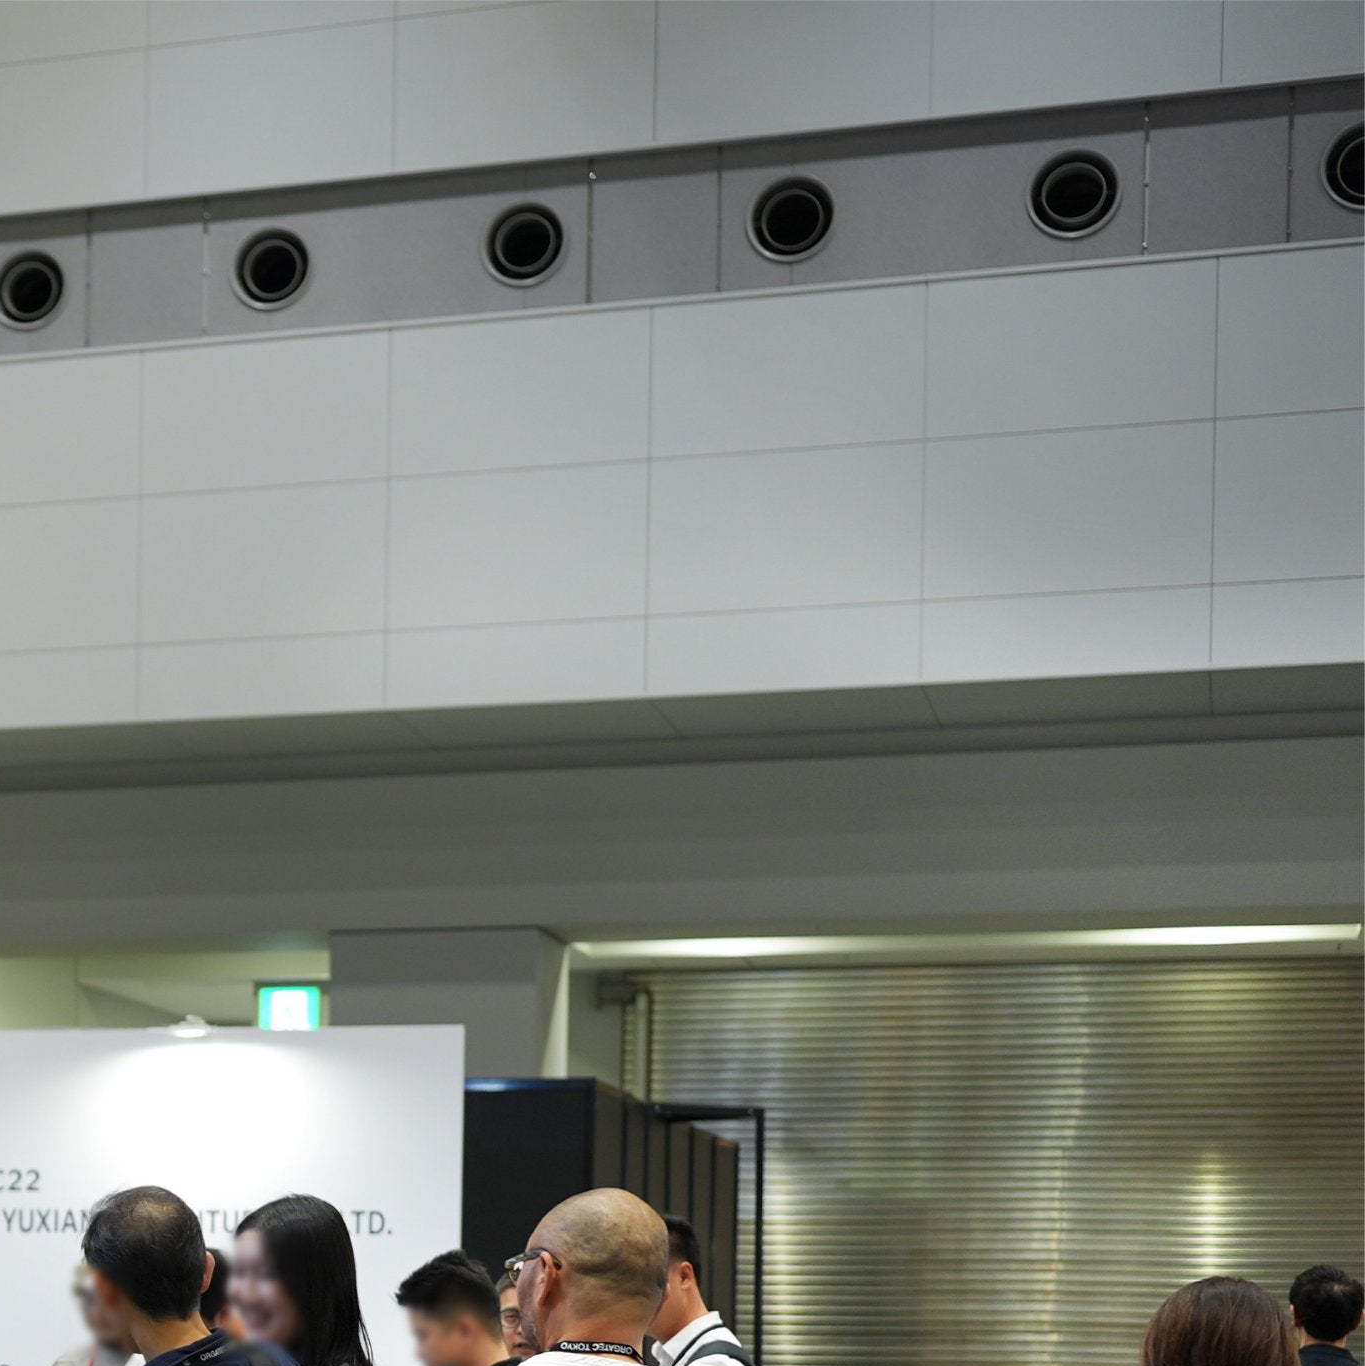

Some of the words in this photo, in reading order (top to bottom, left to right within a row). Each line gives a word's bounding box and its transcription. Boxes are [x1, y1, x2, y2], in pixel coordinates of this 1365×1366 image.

[346, 1209, 392, 1235] TD.
[560, 1341, 590, 1351] TOKYO
[591, 1342, 633, 1355] ORGATEC
